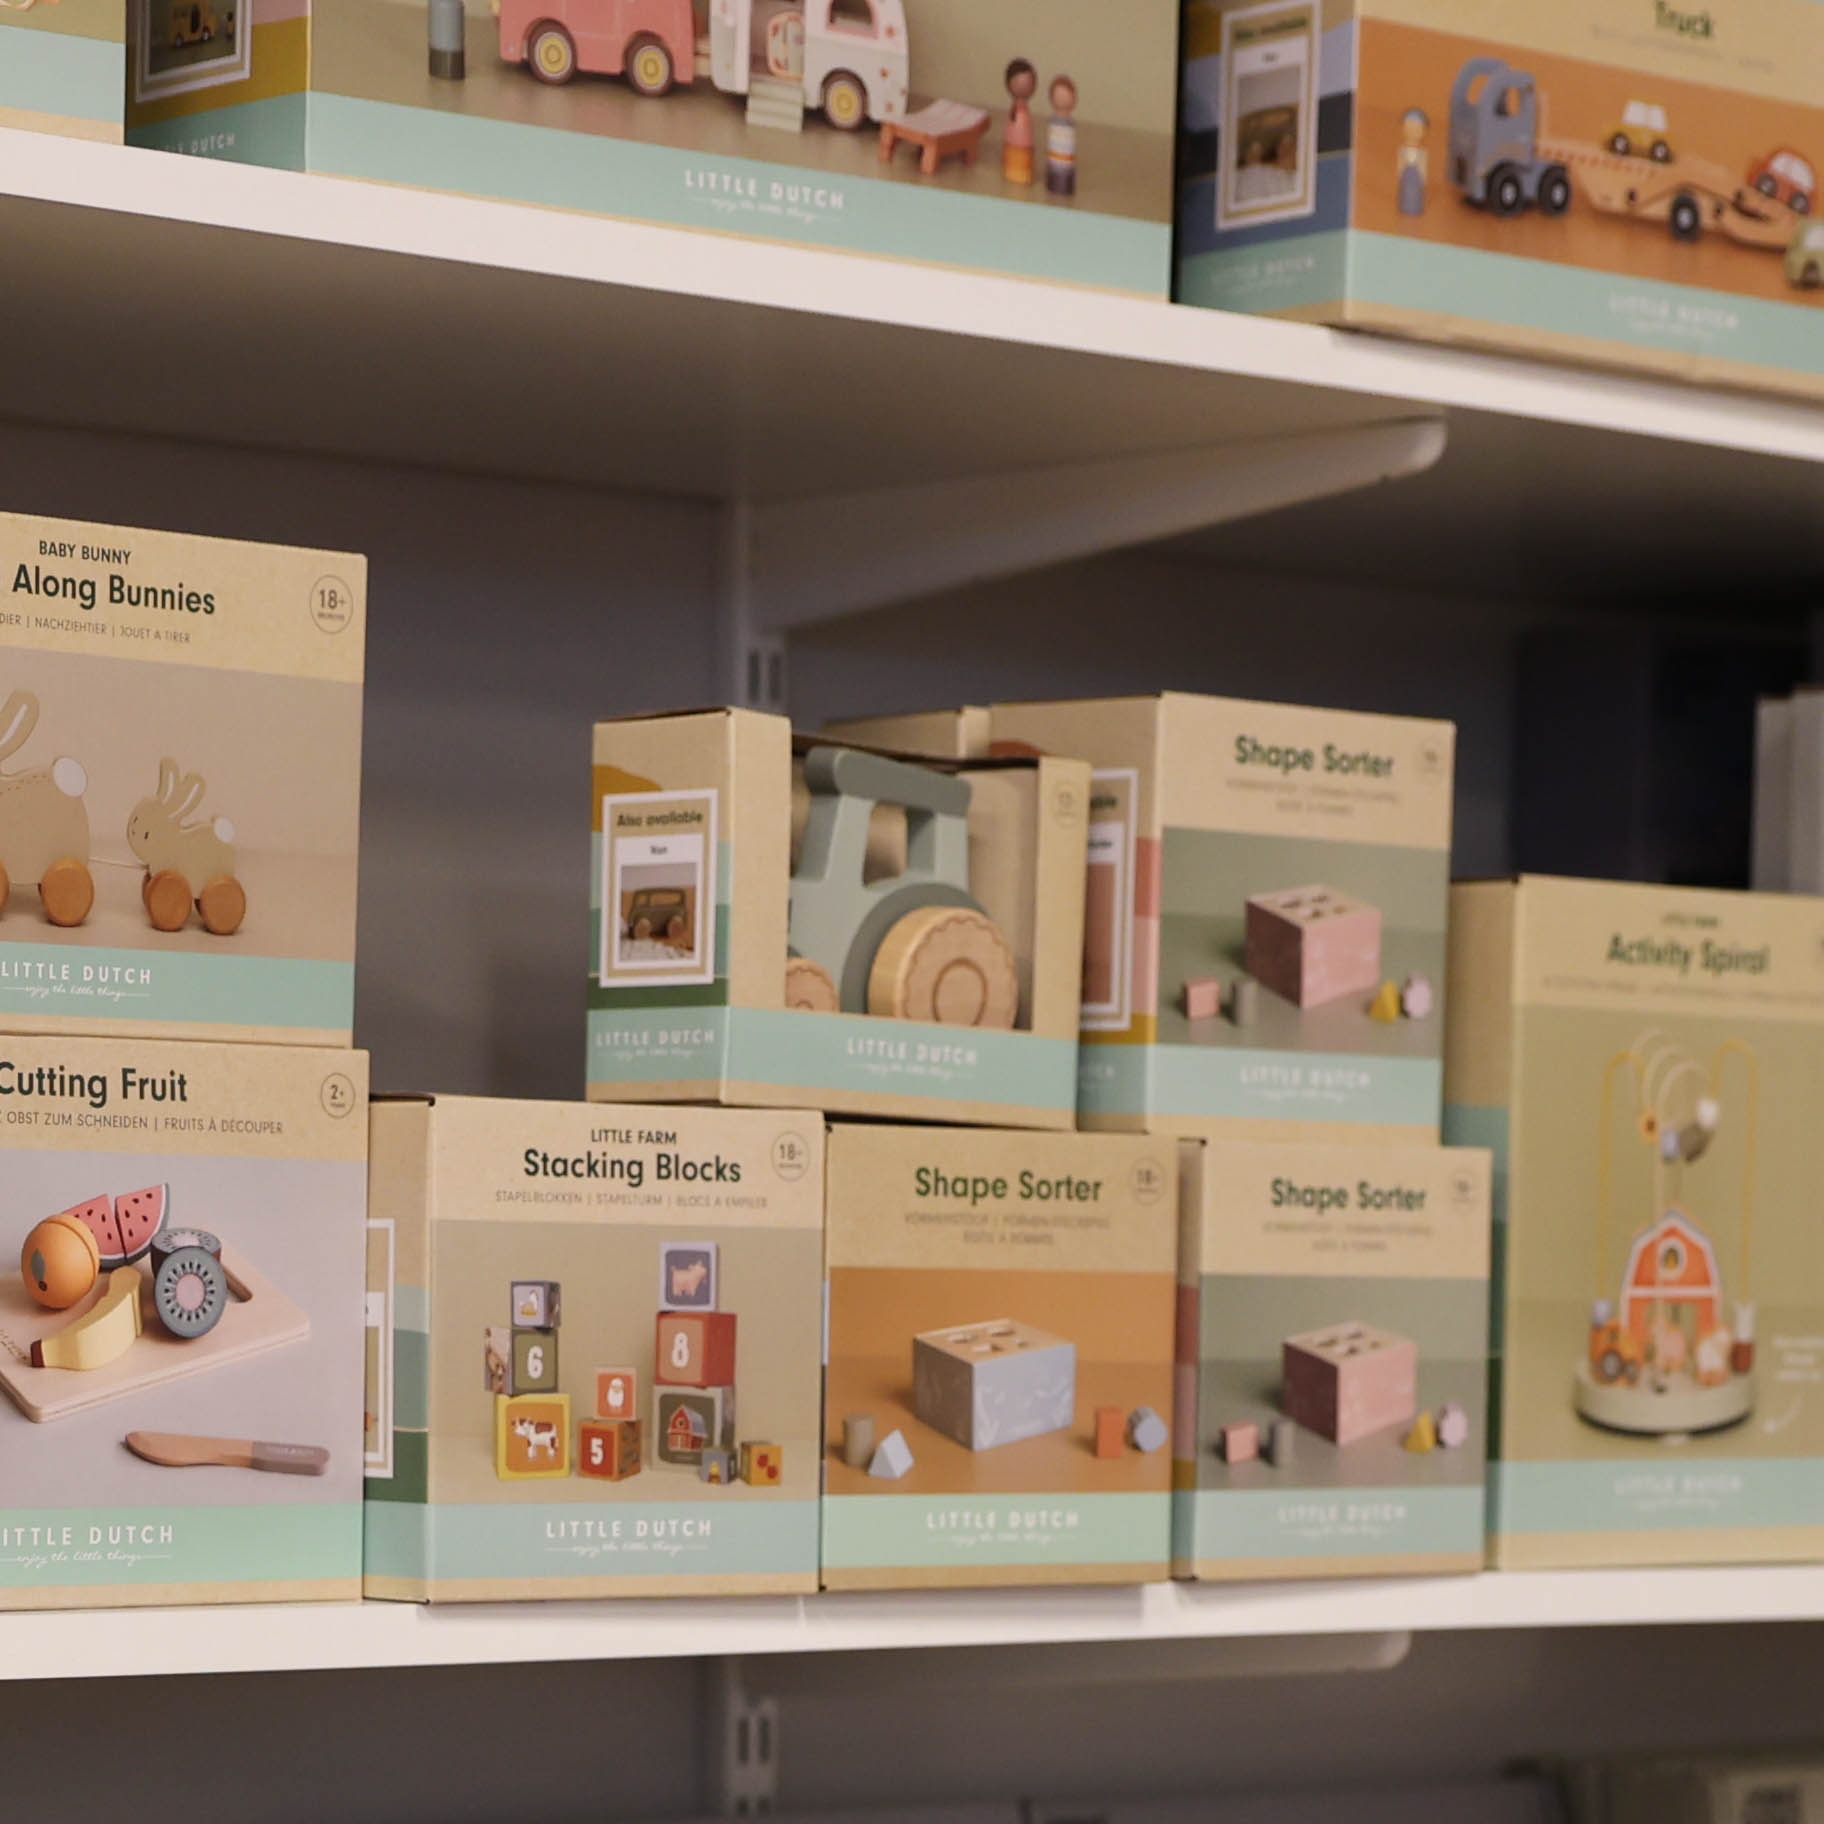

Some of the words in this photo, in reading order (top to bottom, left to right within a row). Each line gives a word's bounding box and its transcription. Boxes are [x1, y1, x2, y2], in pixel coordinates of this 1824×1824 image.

[684, 169, 758, 198] LITTLE
[770, 180, 845, 209] DUTCH
[38, 540, 77, 560] BABY
[81, 544, 132, 566] BUNNY
[12, 563, 97, 611] Along
[108, 574, 216, 615] Bunnies
[35, 617, 107, 636] NACHZIEHTIER
[1234, 734, 1315, 776] Shape
[1322, 741, 1395, 779] Sorter
[1606, 932, 1693, 976] Activity
[1700, 938, 1771, 976] Spiral
[1, 961, 70, 980] LITTLE
[82, 965, 152, 985] DUTCH
[121, 1067, 188, 1102] Fruit
[6, 1111, 39, 1125] OBST
[44, 1112, 73, 1127] ZUM
[76, 1113, 149, 1129] SCHNEIDEN
[163, 1116, 205, 1132] FRUITS
[591, 1129, 633, 1144] LITTLE
[638, 1131, 677, 1145] FARM
[523, 1147, 644, 1188] Stacking
[656, 1152, 742, 1182] Blocks
[915, 1167, 1008, 1206] Shape
[1018, 1170, 1103, 1202] Sorter
[1270, 1176, 1348, 1216] Shape
[1357, 1180, 1428, 1212] Sorter
[527, 1345, 544, 1379] 6
[671, 1331, 690, 1368] 8
[590, 1437, 604, 1465] 5
[88, 1525, 173, 1545] DUTCH
[546, 1520, 622, 1539] LITTLE
[636, 1519, 712, 1537] DUTCH
